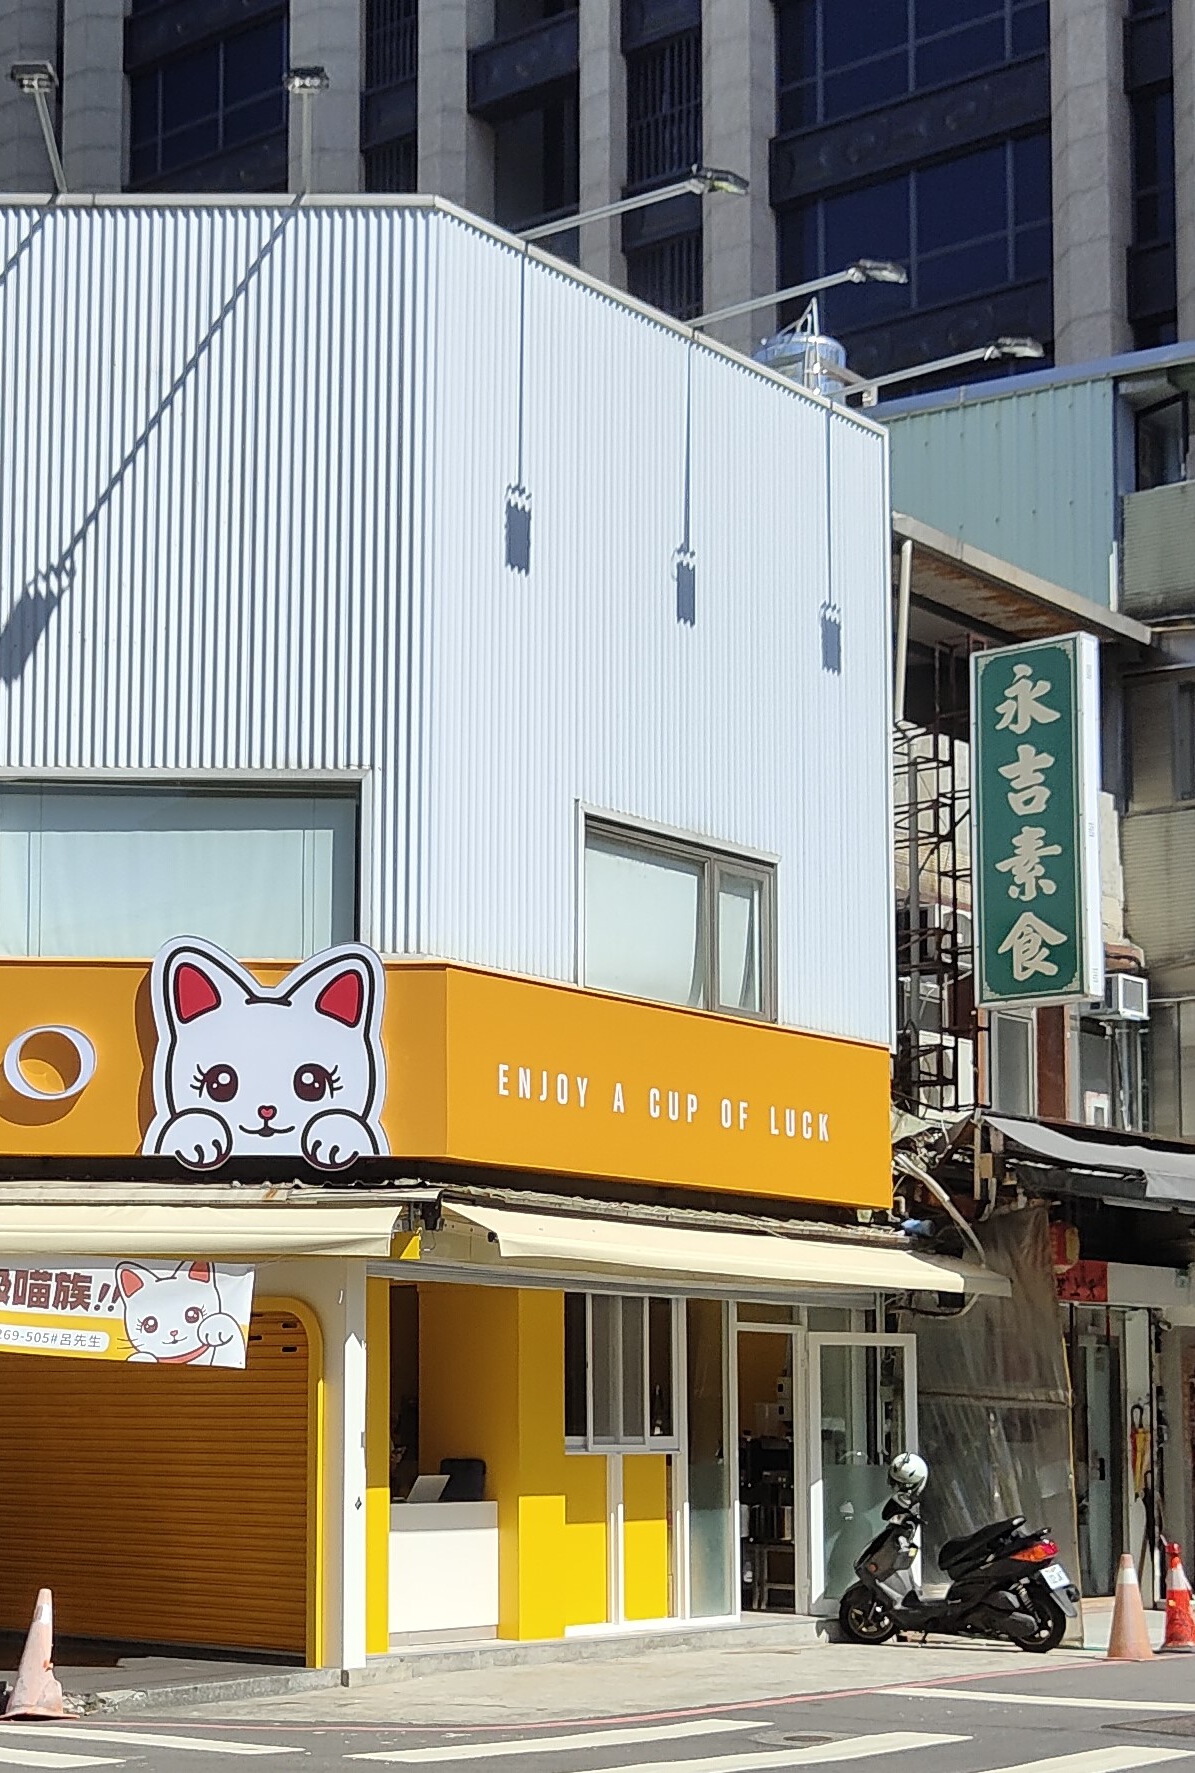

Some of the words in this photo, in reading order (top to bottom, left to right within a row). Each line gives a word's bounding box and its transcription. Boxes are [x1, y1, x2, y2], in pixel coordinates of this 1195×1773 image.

[995, 664, 1068, 982] 永吉素食
[498, 1063, 588, 1108] ENJOY
[613, 1082, 625, 1113] A
[649, 1087, 698, 1123] CUP
[721, 1098, 748, 1130] OF
[770, 1105, 829, 1142] LUCK
